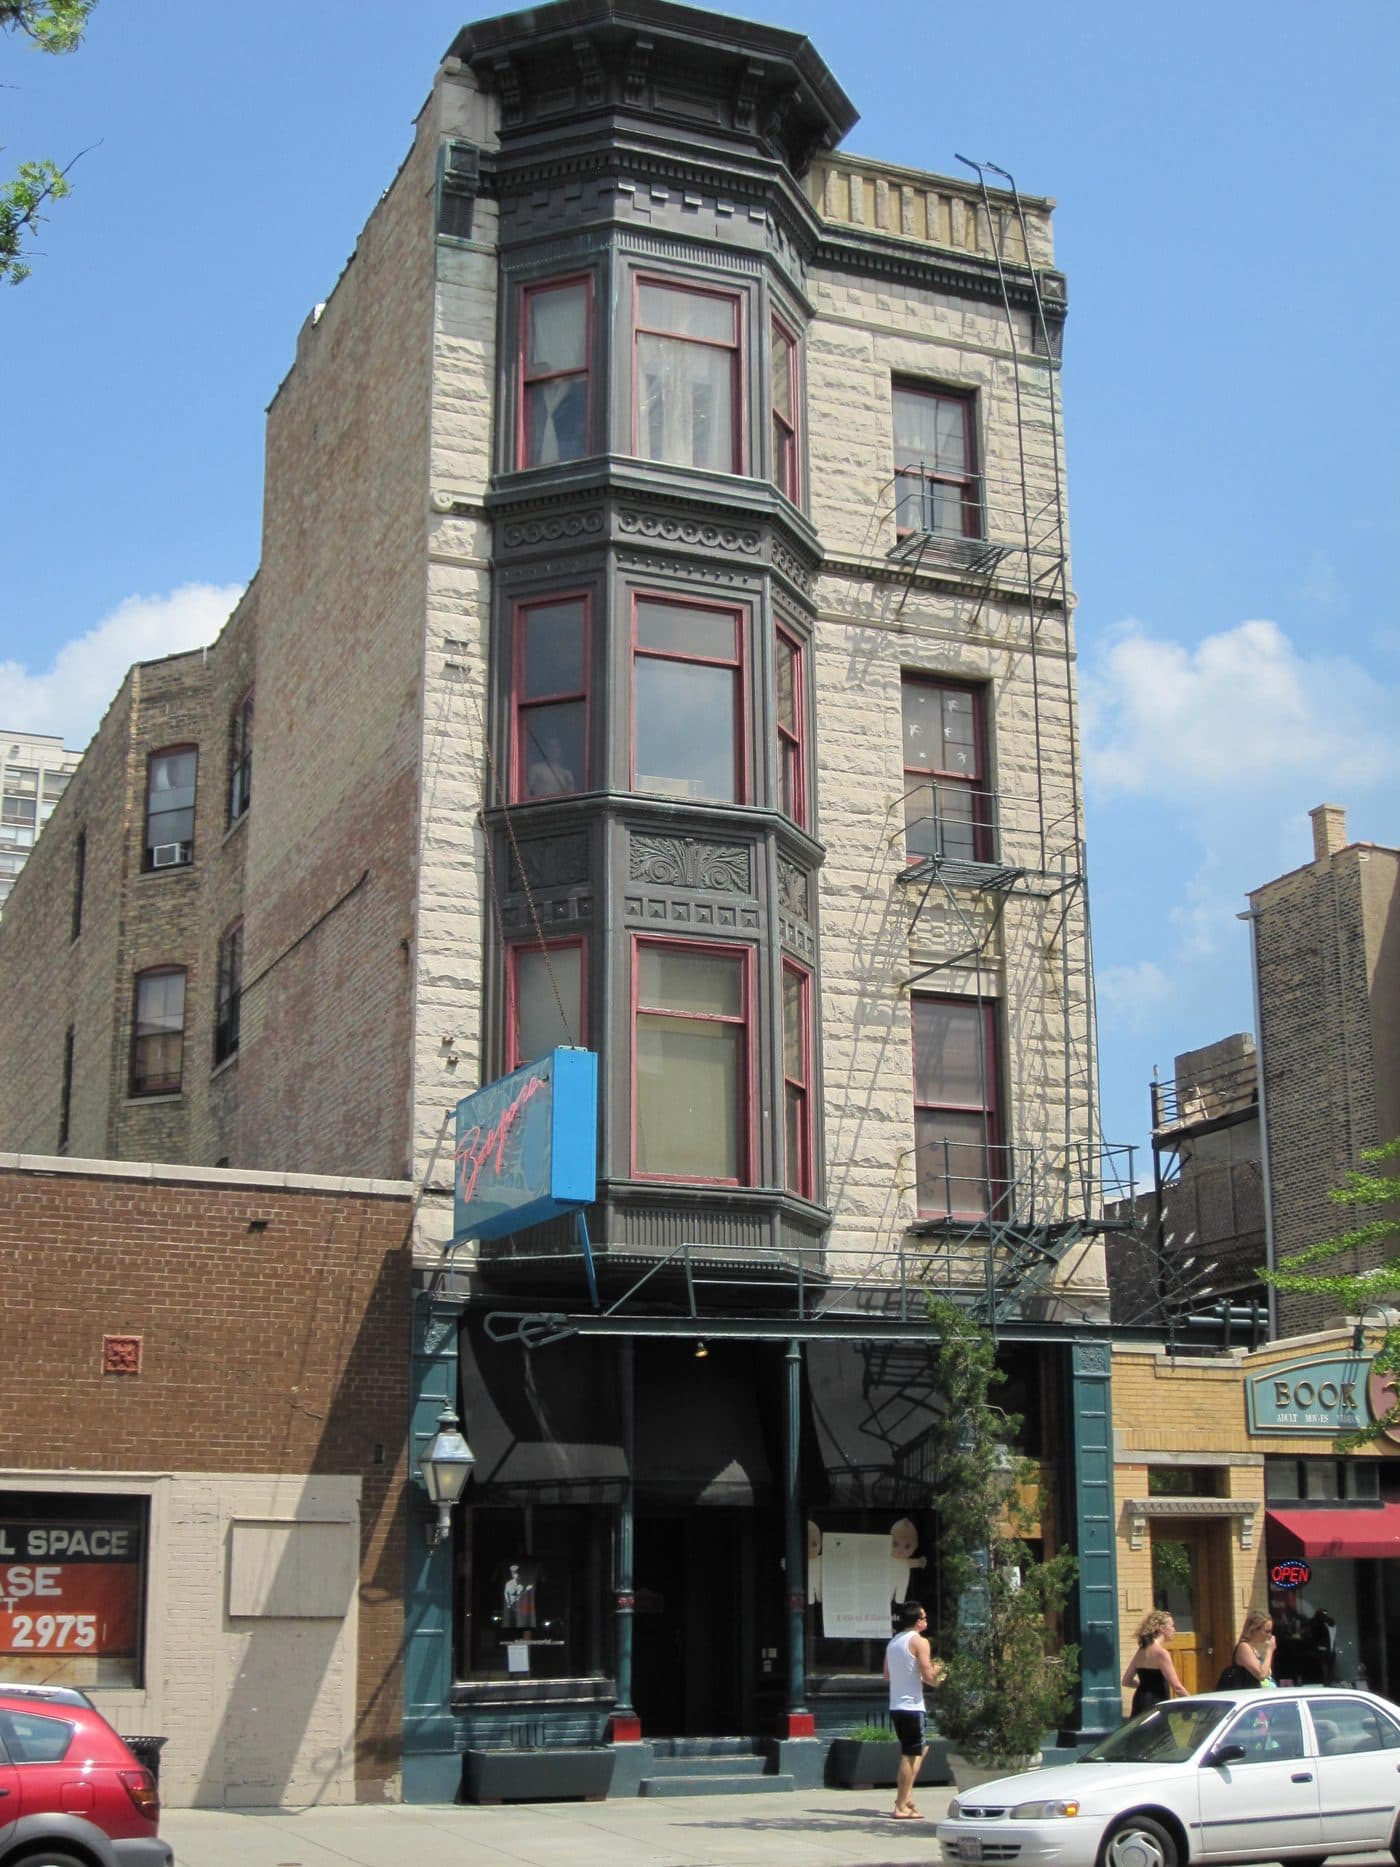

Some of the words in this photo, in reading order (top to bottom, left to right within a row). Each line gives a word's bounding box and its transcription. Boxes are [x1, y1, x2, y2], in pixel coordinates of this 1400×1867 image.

[1274, 1380, 1358, 1409] BOOK
[27, 1529, 129, 1556] SPACE
[1271, 1566, 1309, 1583] OPEN
[12, 1615, 97, 1648] 2975
